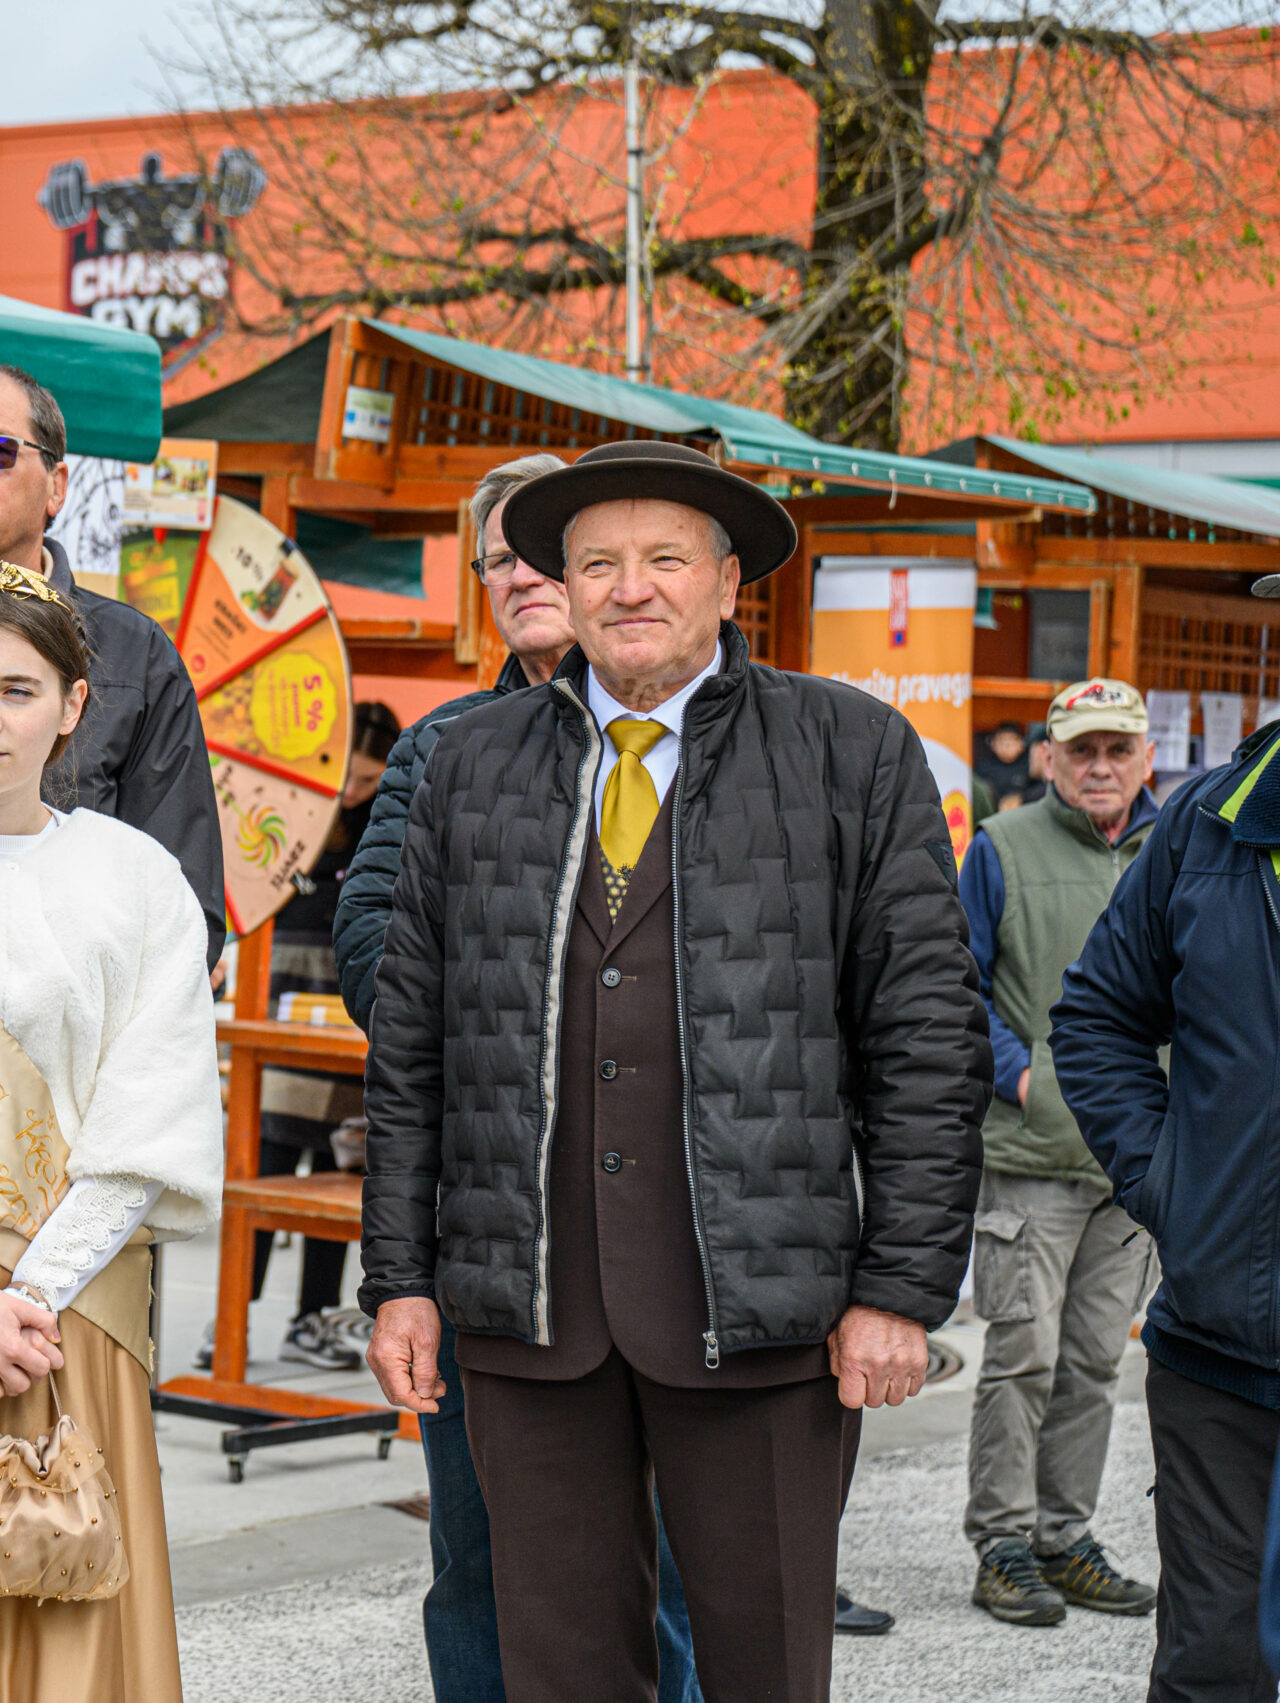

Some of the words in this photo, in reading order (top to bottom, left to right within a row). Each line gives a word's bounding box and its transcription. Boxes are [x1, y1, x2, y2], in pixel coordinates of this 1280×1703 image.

[91, 295, 201, 337] GYM
[303, 675, 322, 692] 5
[306, 699, 324, 732] %
